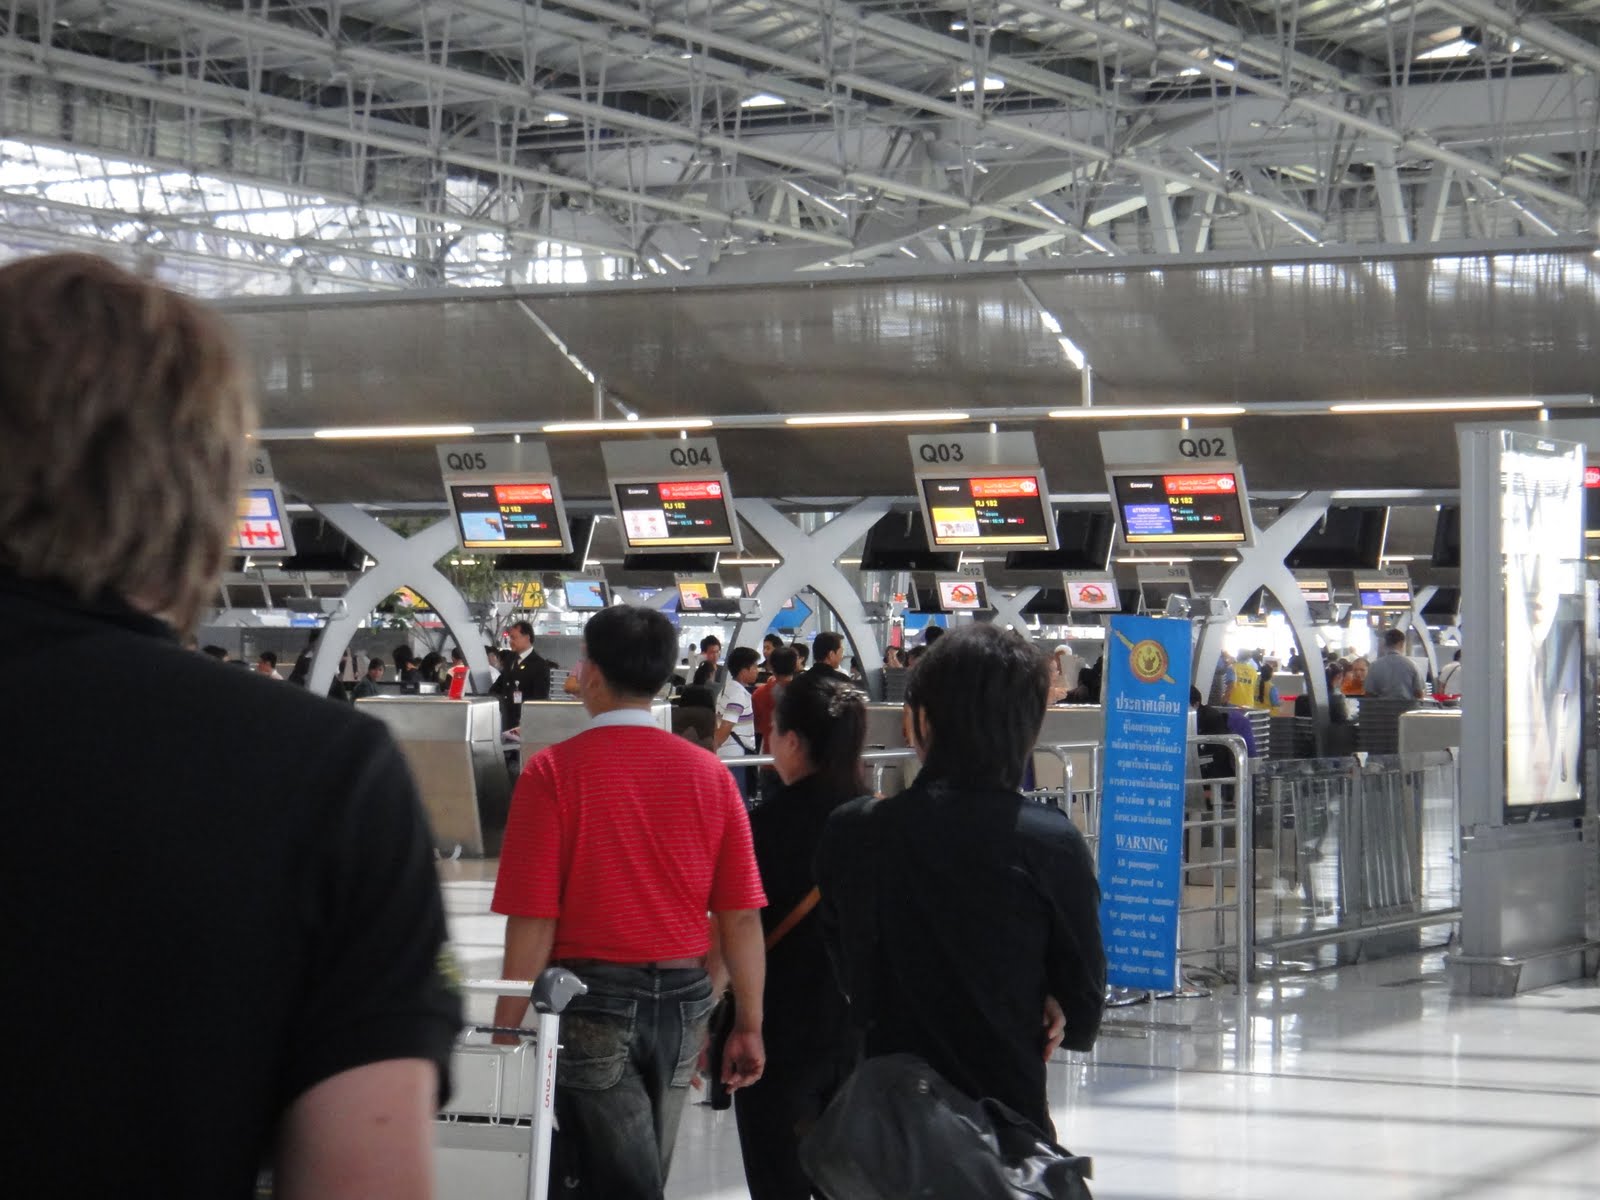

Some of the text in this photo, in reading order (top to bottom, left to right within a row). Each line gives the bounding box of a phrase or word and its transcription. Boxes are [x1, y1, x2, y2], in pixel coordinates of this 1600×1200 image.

[670, 447, 712, 467] Q04
[920, 443, 964, 463] Q03
[1179, 438, 1226, 458] Q02
[447, 452, 487, 471] Q05
[663, 502, 674, 510] RJ
[1115, 690, 1181, 714] ประกาศเตือน
[1115, 834, 1168, 851] WARNING
[1128, 861, 1160, 872] passengers
[1120, 911, 1146, 923] passport
[1148, 913, 1166, 924] check
[1129, 929, 1147, 939] check
